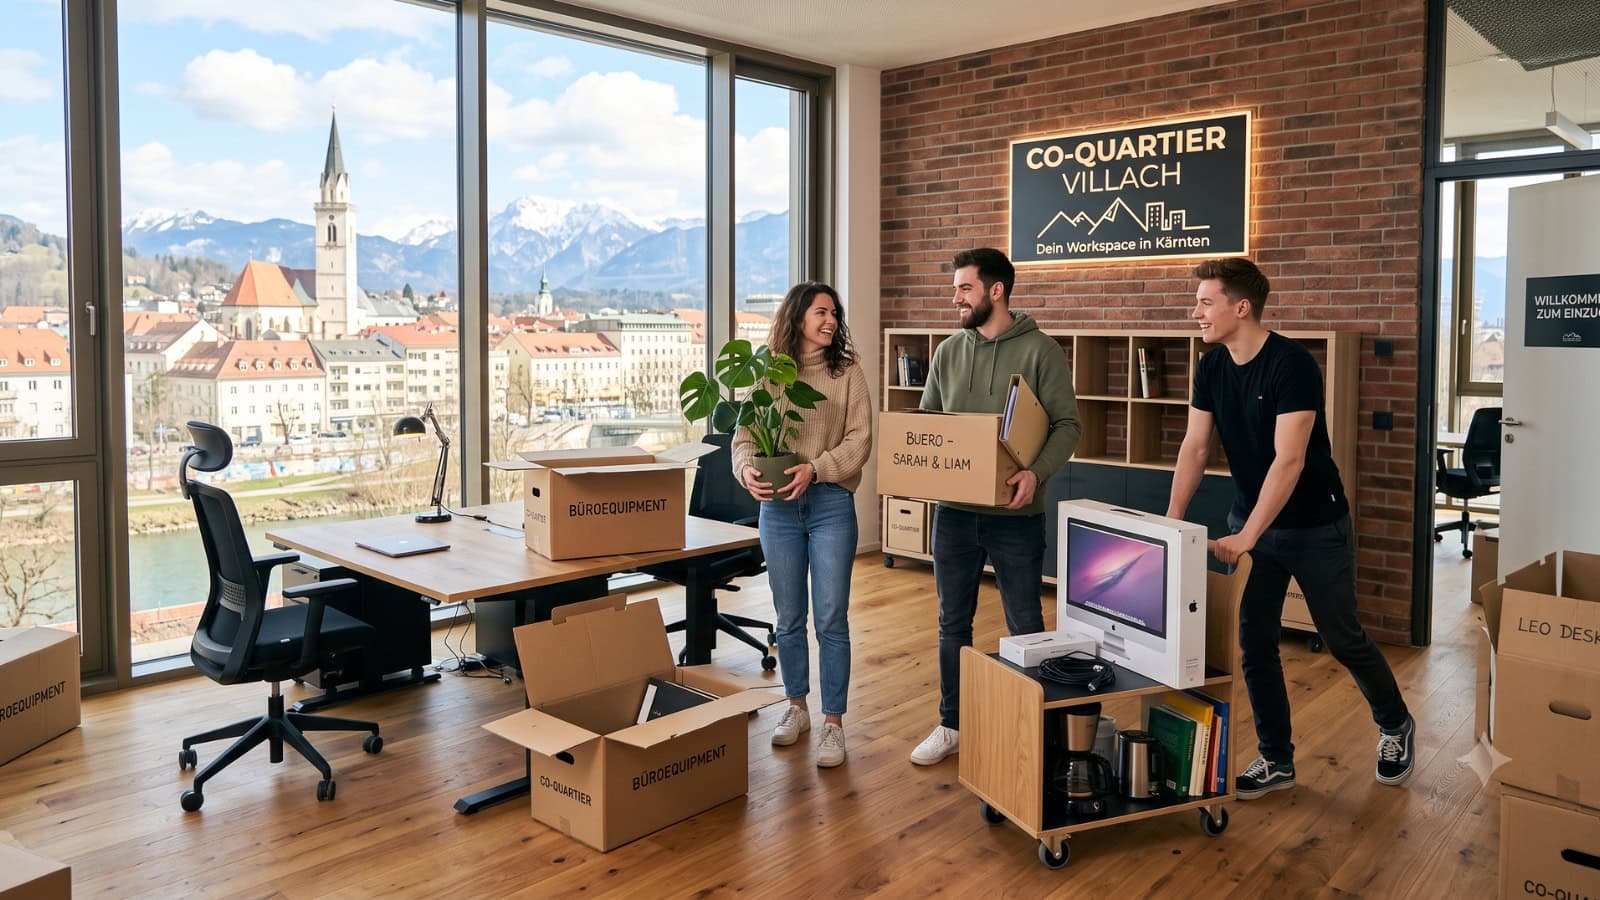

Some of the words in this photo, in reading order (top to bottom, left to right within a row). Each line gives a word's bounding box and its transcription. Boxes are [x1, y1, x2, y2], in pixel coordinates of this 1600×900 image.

[1026, 126, 1226, 169] CO-QUARTIER
[1062, 161, 1182, 194] VILLACH
[1036, 242, 1064, 254] Dein
[1067, 238, 1136, 254] Workspace
[1140, 237, 1151, 249] in
[1156, 235, 1210, 249] Kärnten
[1536, 308, 1561, 319] ZUM
[906, 431, 943, 447] BUERO
[893, 453, 928, 467] SARAH
[931, 456, 940, 469] &
[944, 456, 971, 471] LIAM
[569, 498, 668, 517] BÜROEQUIPMENT
[1518, 616, 1551, 636] LEO
[632, 744, 728, 791] BÜROEQUIPMENT
[540, 775, 592, 807] CO-QUARTIER
[1524, 880, 1600, 900] CO-QU
